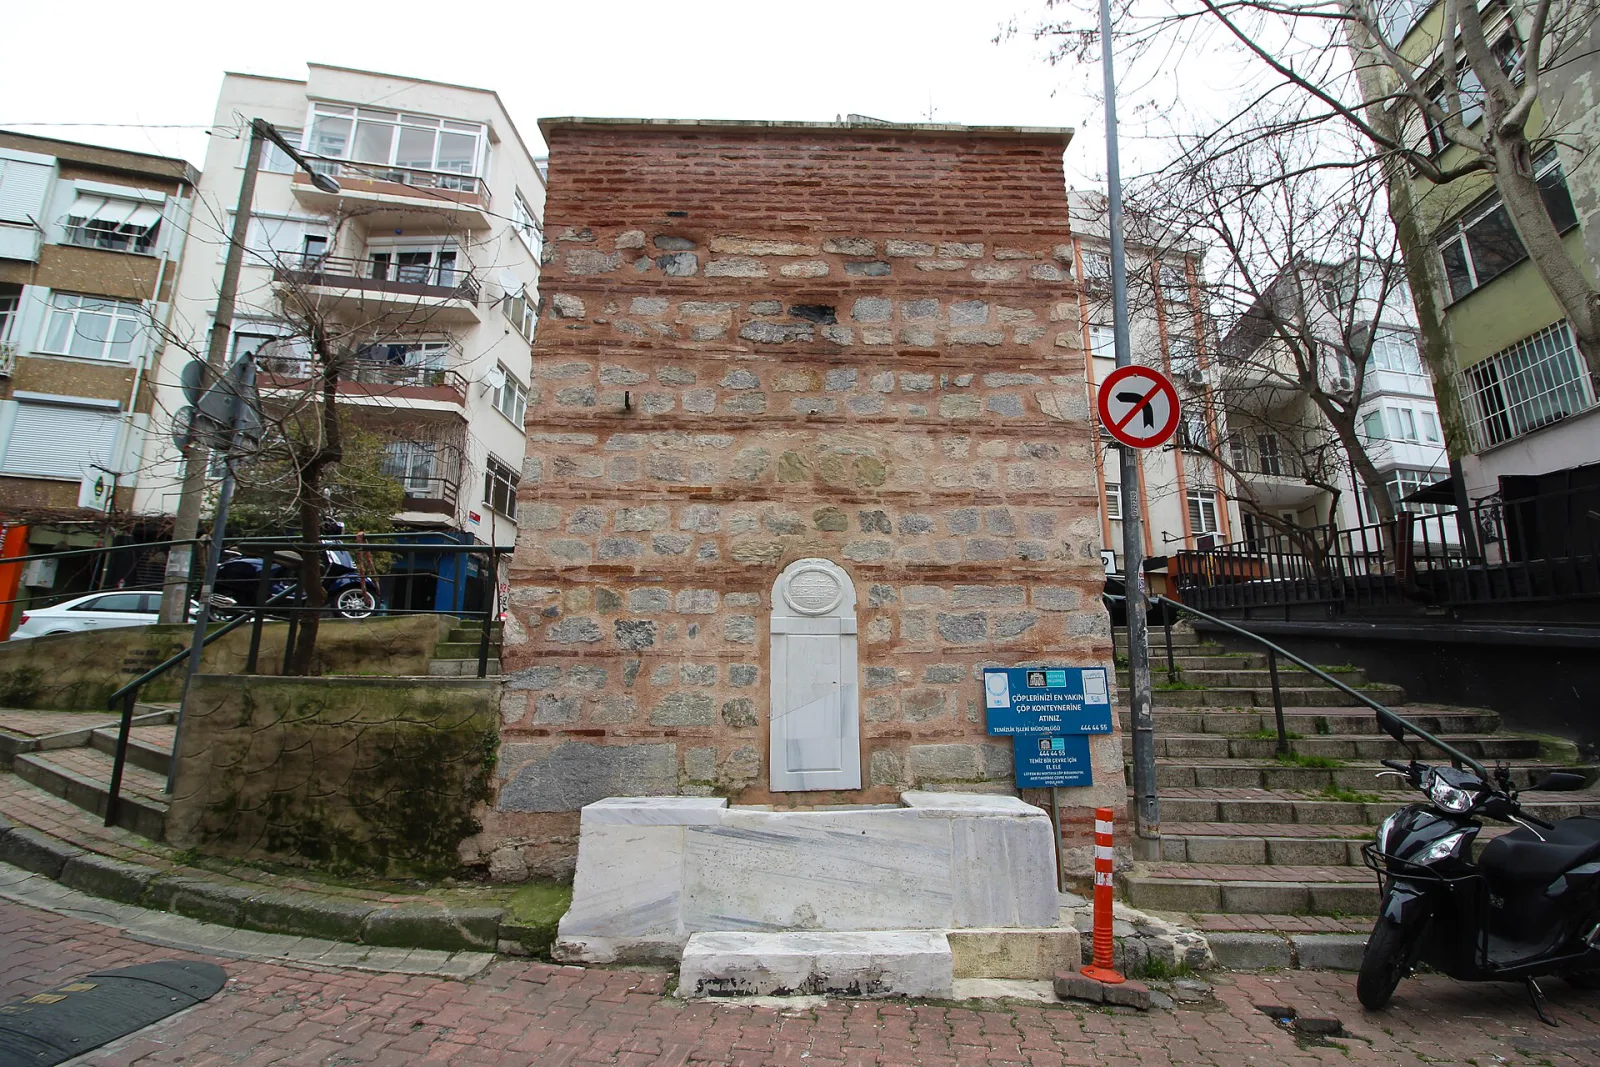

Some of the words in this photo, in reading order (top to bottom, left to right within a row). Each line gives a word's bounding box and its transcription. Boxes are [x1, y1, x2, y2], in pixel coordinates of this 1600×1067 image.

[1012, 693, 1053, 703] ÇÖPLERİNİZİ
[1016, 704, 1030, 713] ÇÖP
[1032, 703, 1082, 712] KONTEYNERİNE
[1100, 723, 1108, 731] 55
[1058, 749, 1066, 757] 55
